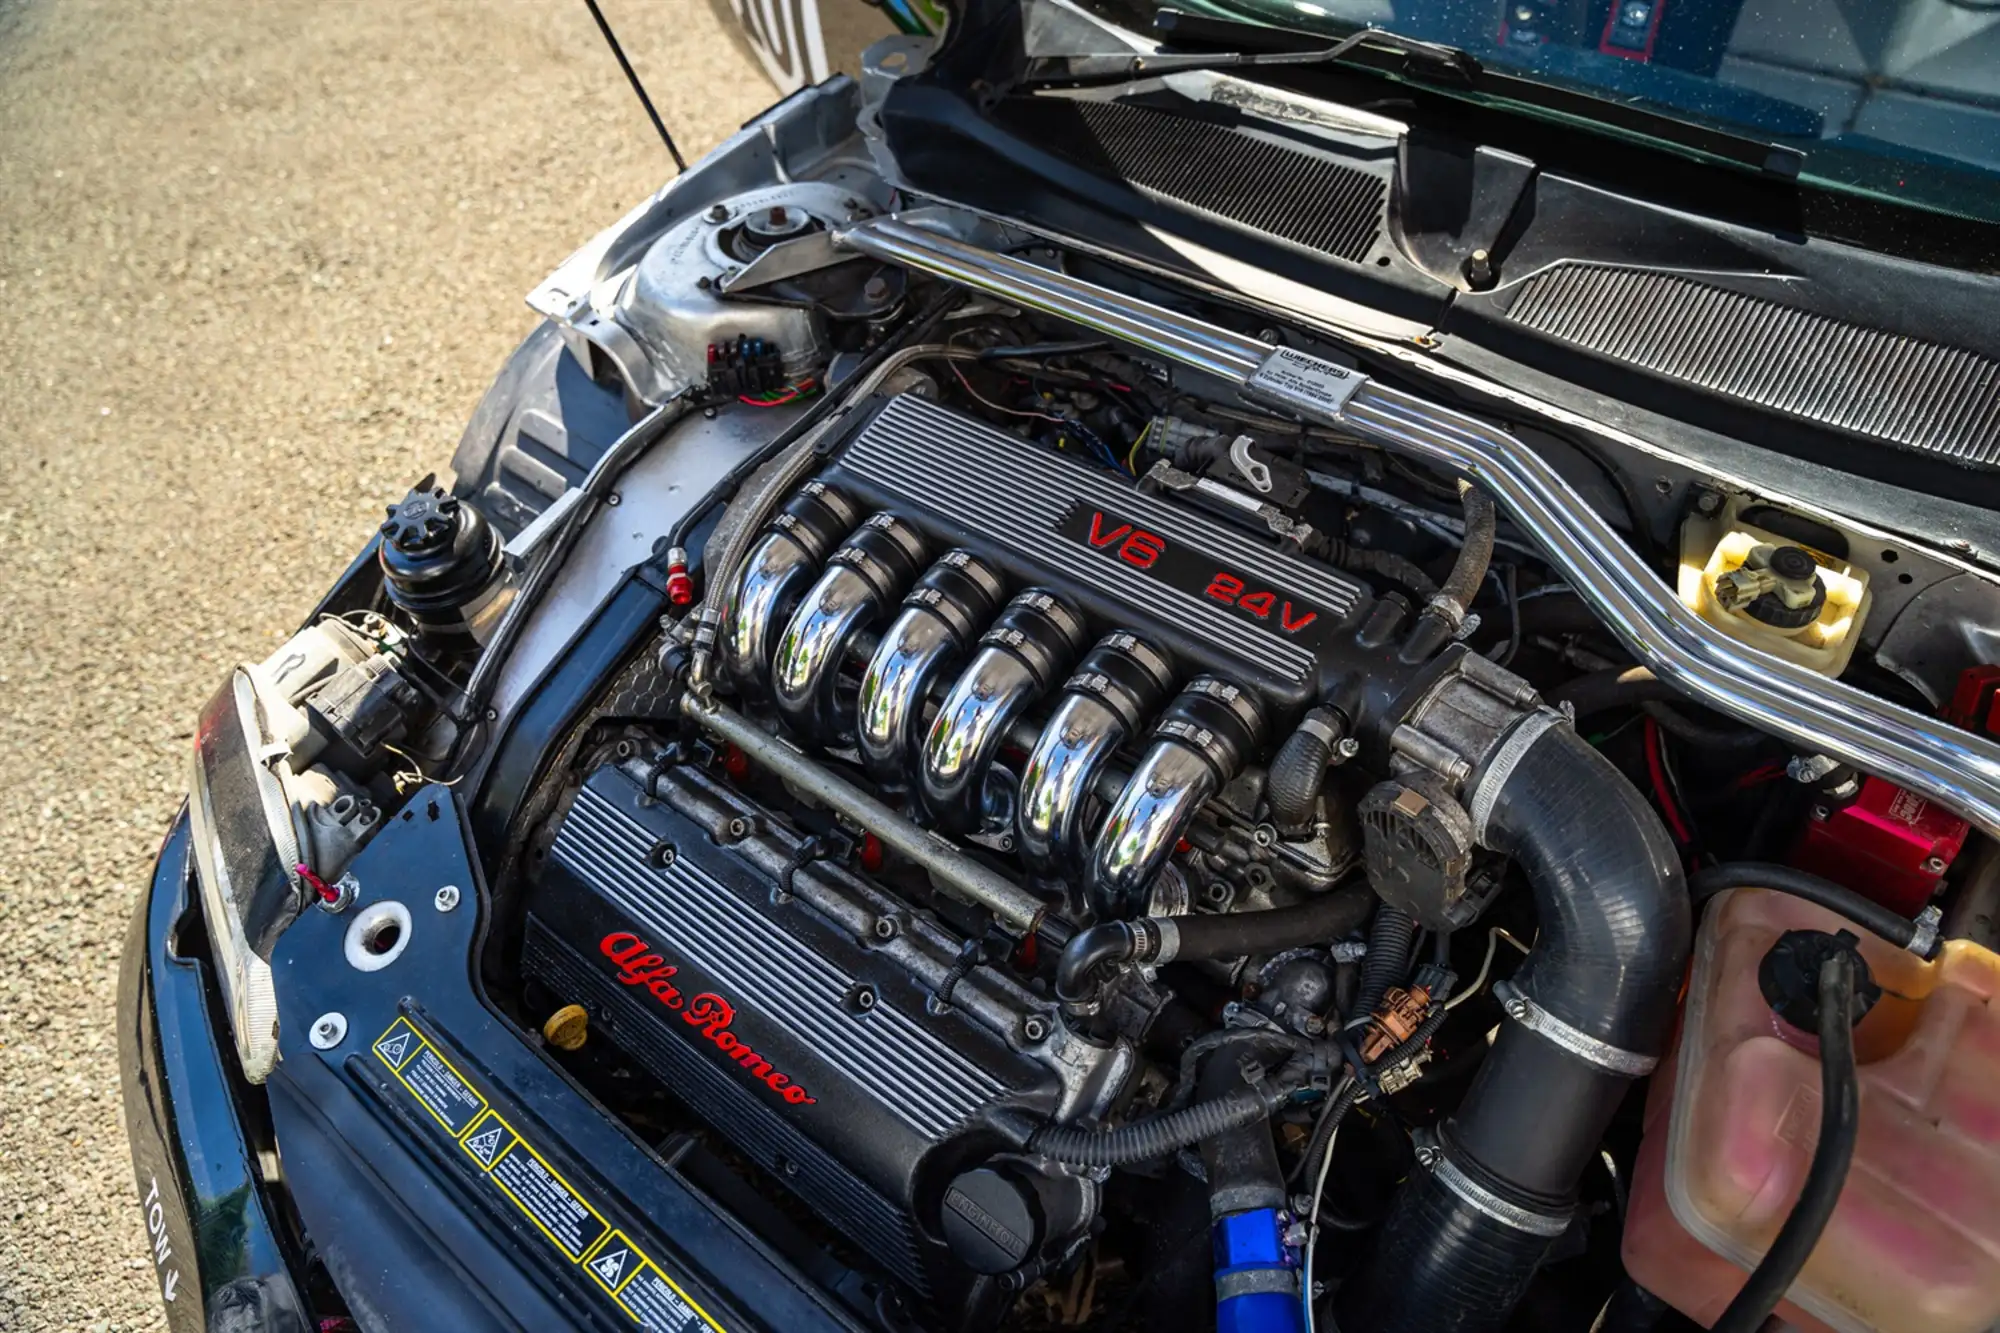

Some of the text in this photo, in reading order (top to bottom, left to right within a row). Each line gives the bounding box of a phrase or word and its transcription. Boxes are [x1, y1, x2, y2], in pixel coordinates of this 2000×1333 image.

[1088, 512, 1318, 633] V6 24V
[600, 932, 817, 1105] Alfa Romeo
[145, 1177, 172, 1265] TOW
